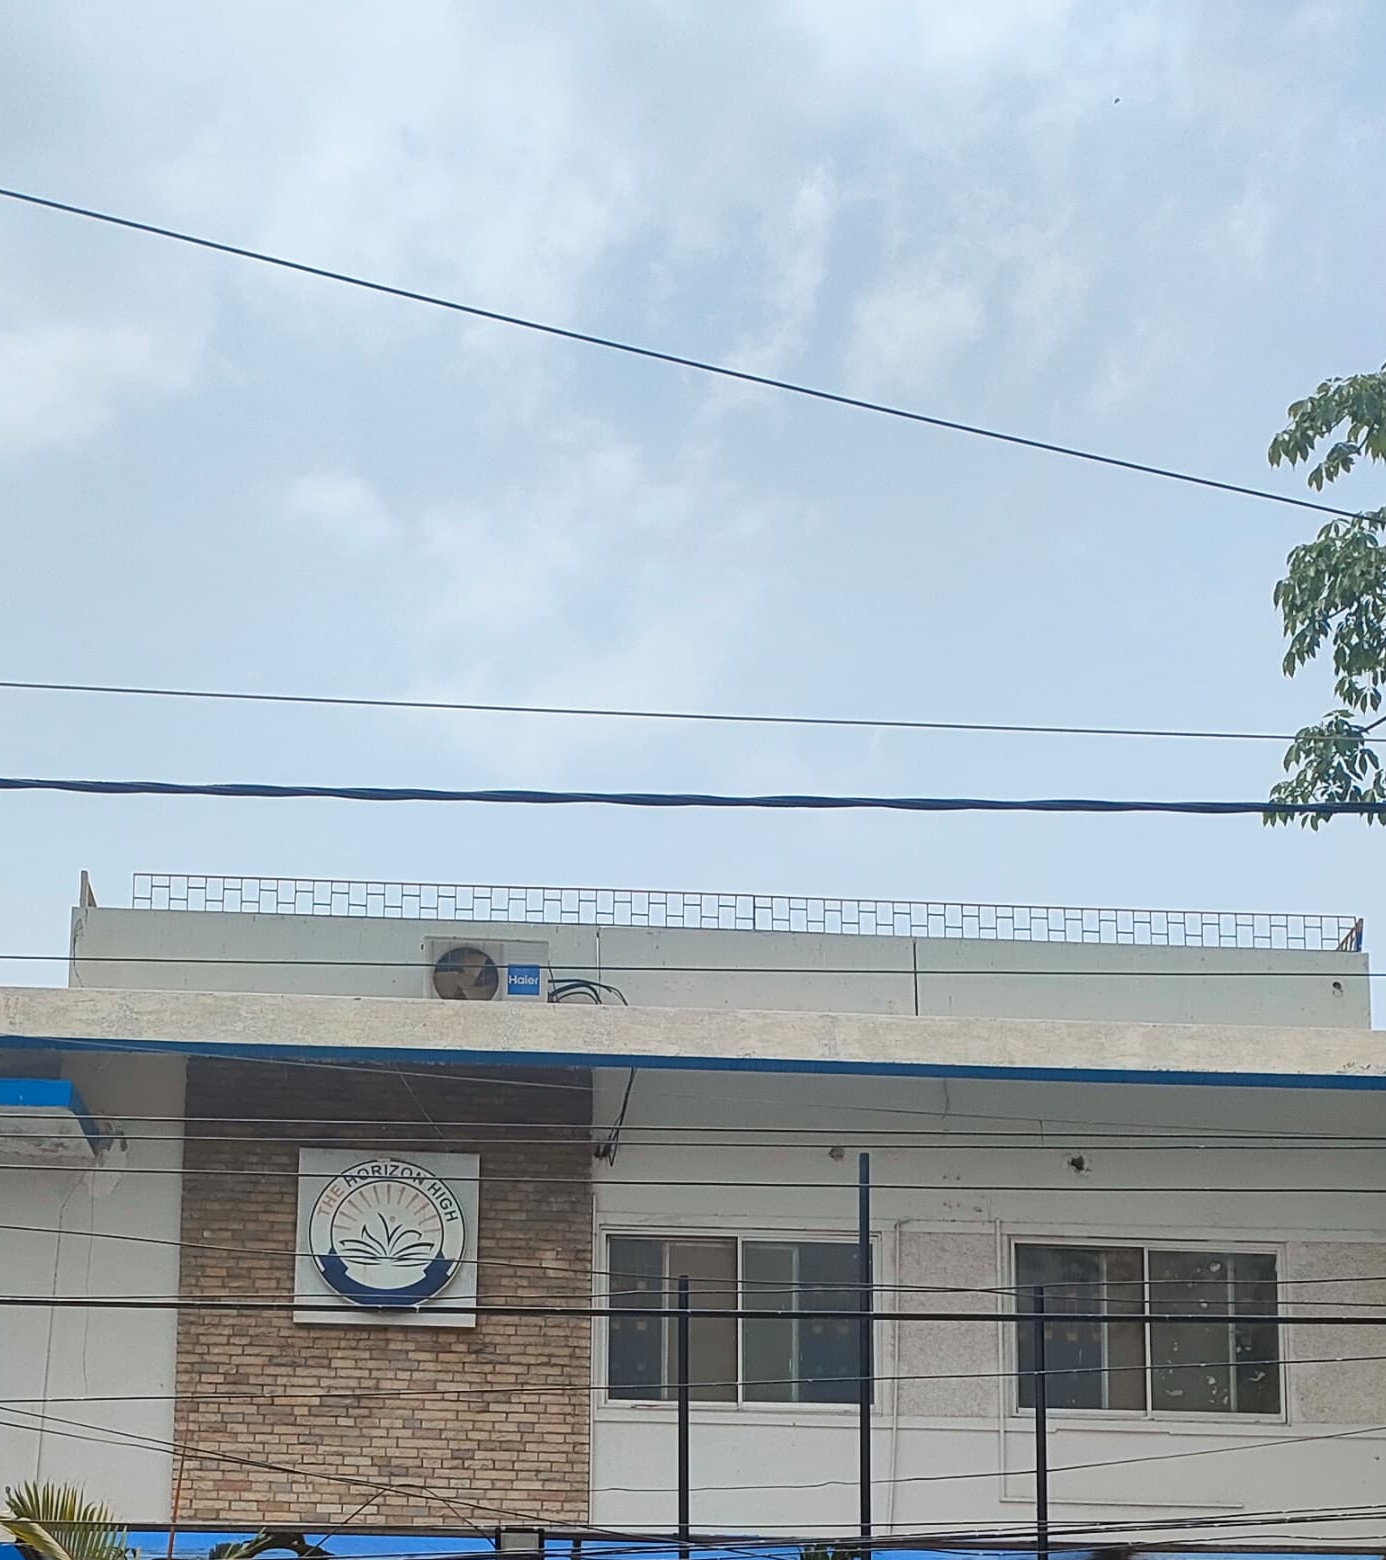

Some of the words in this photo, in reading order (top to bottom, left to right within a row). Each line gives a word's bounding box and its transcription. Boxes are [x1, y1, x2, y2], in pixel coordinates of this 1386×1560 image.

[508, 975, 538, 985] Haier
[317, 1184, 345, 1217] THE
[344, 1164, 428, 1188] HORIZON
[427, 1182, 459, 1222] HIGH
